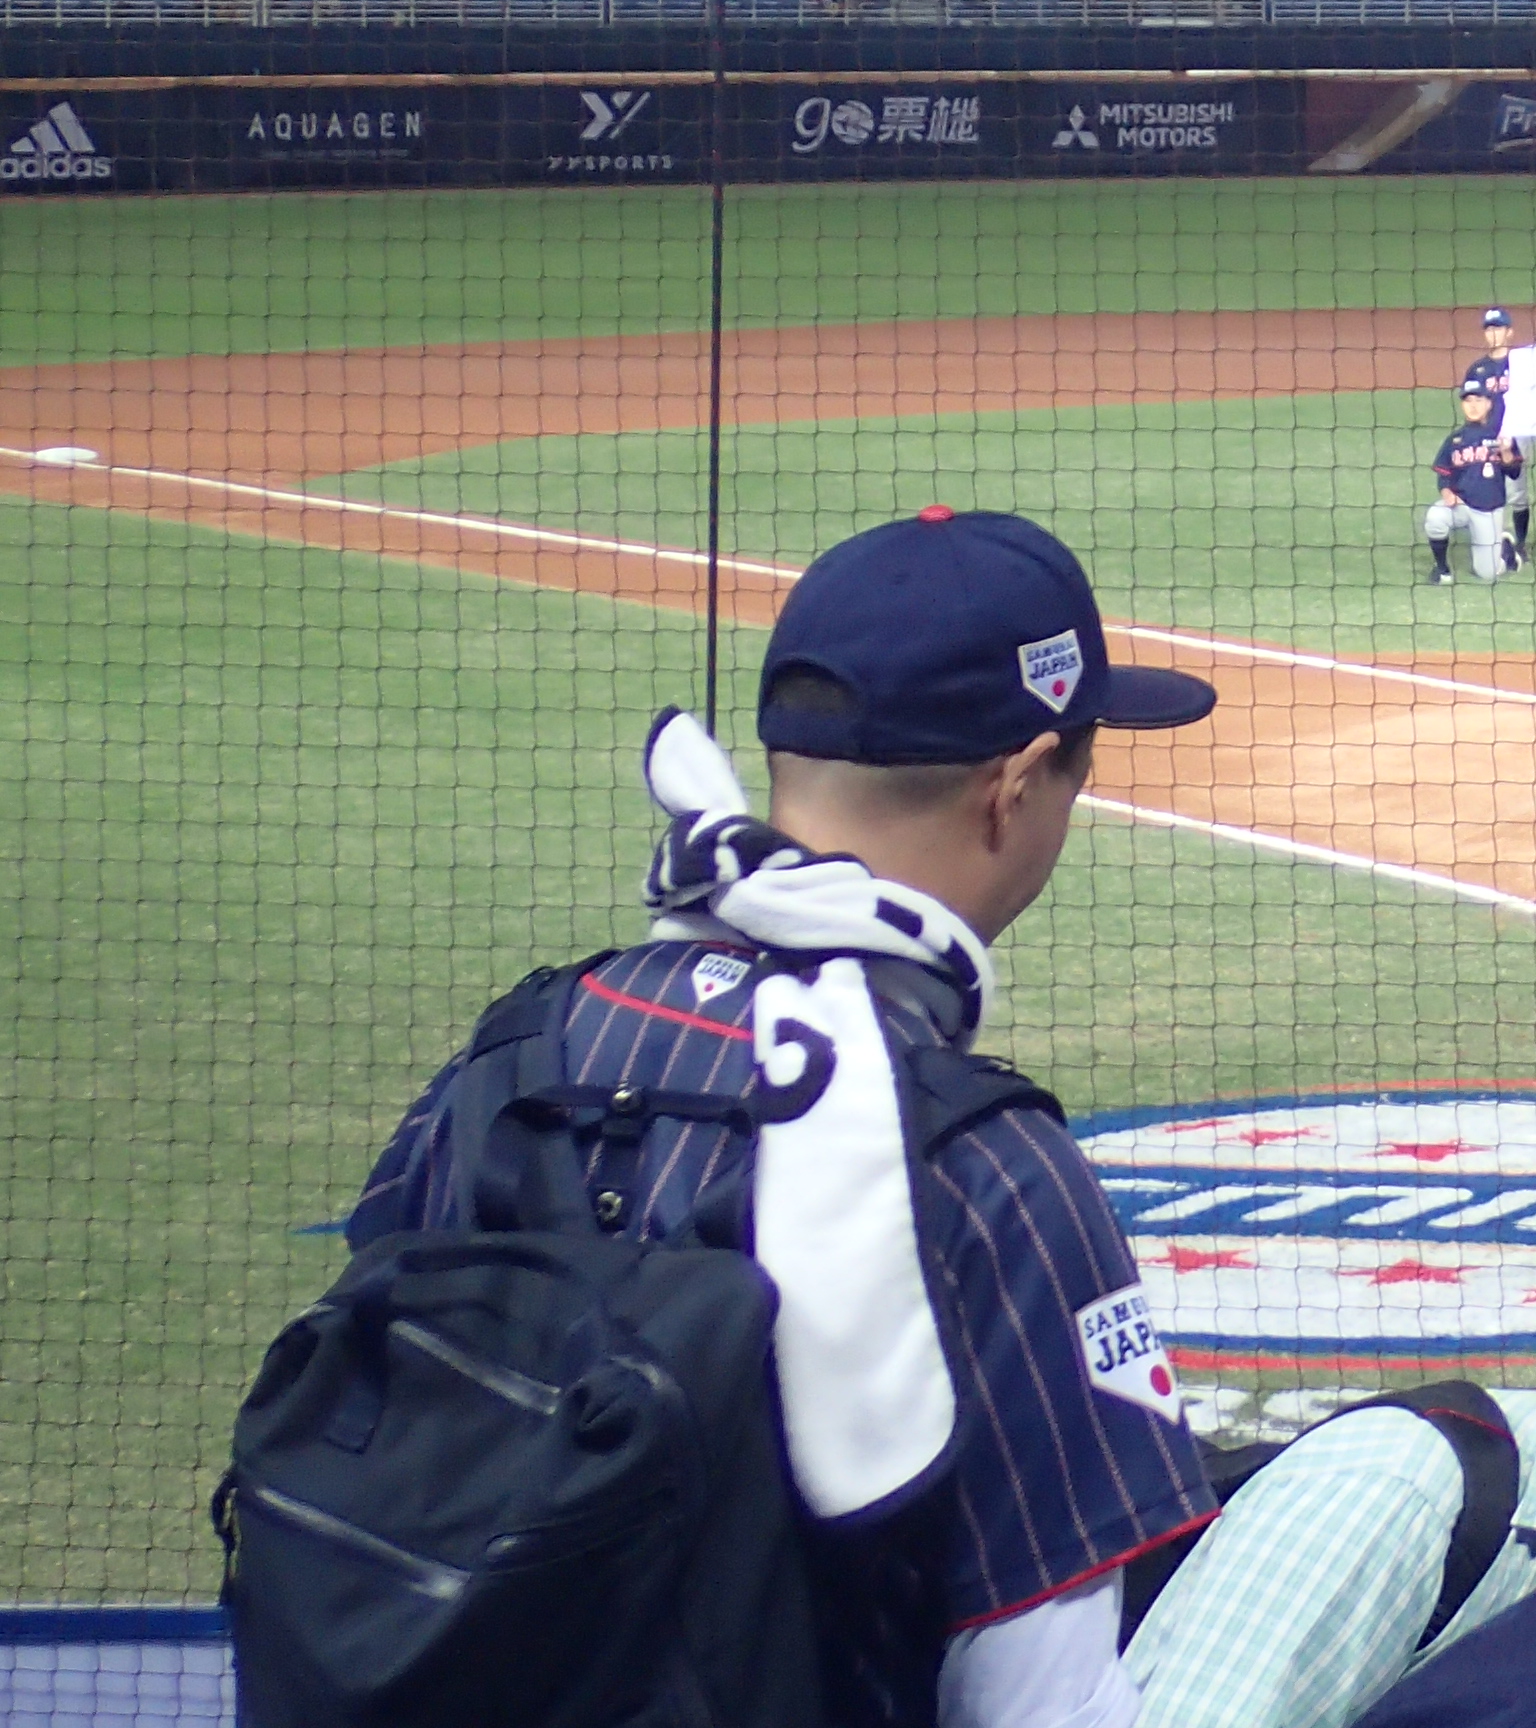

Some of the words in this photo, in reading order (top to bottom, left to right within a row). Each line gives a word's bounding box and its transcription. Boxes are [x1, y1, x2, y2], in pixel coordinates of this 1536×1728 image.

[248, 111, 421, 140] AQUAGEN
[1100, 103, 1234, 124] MITSUBISHI
[1117, 126, 1218, 148] MOTORS
[0, 152, 113, 179] adidas
